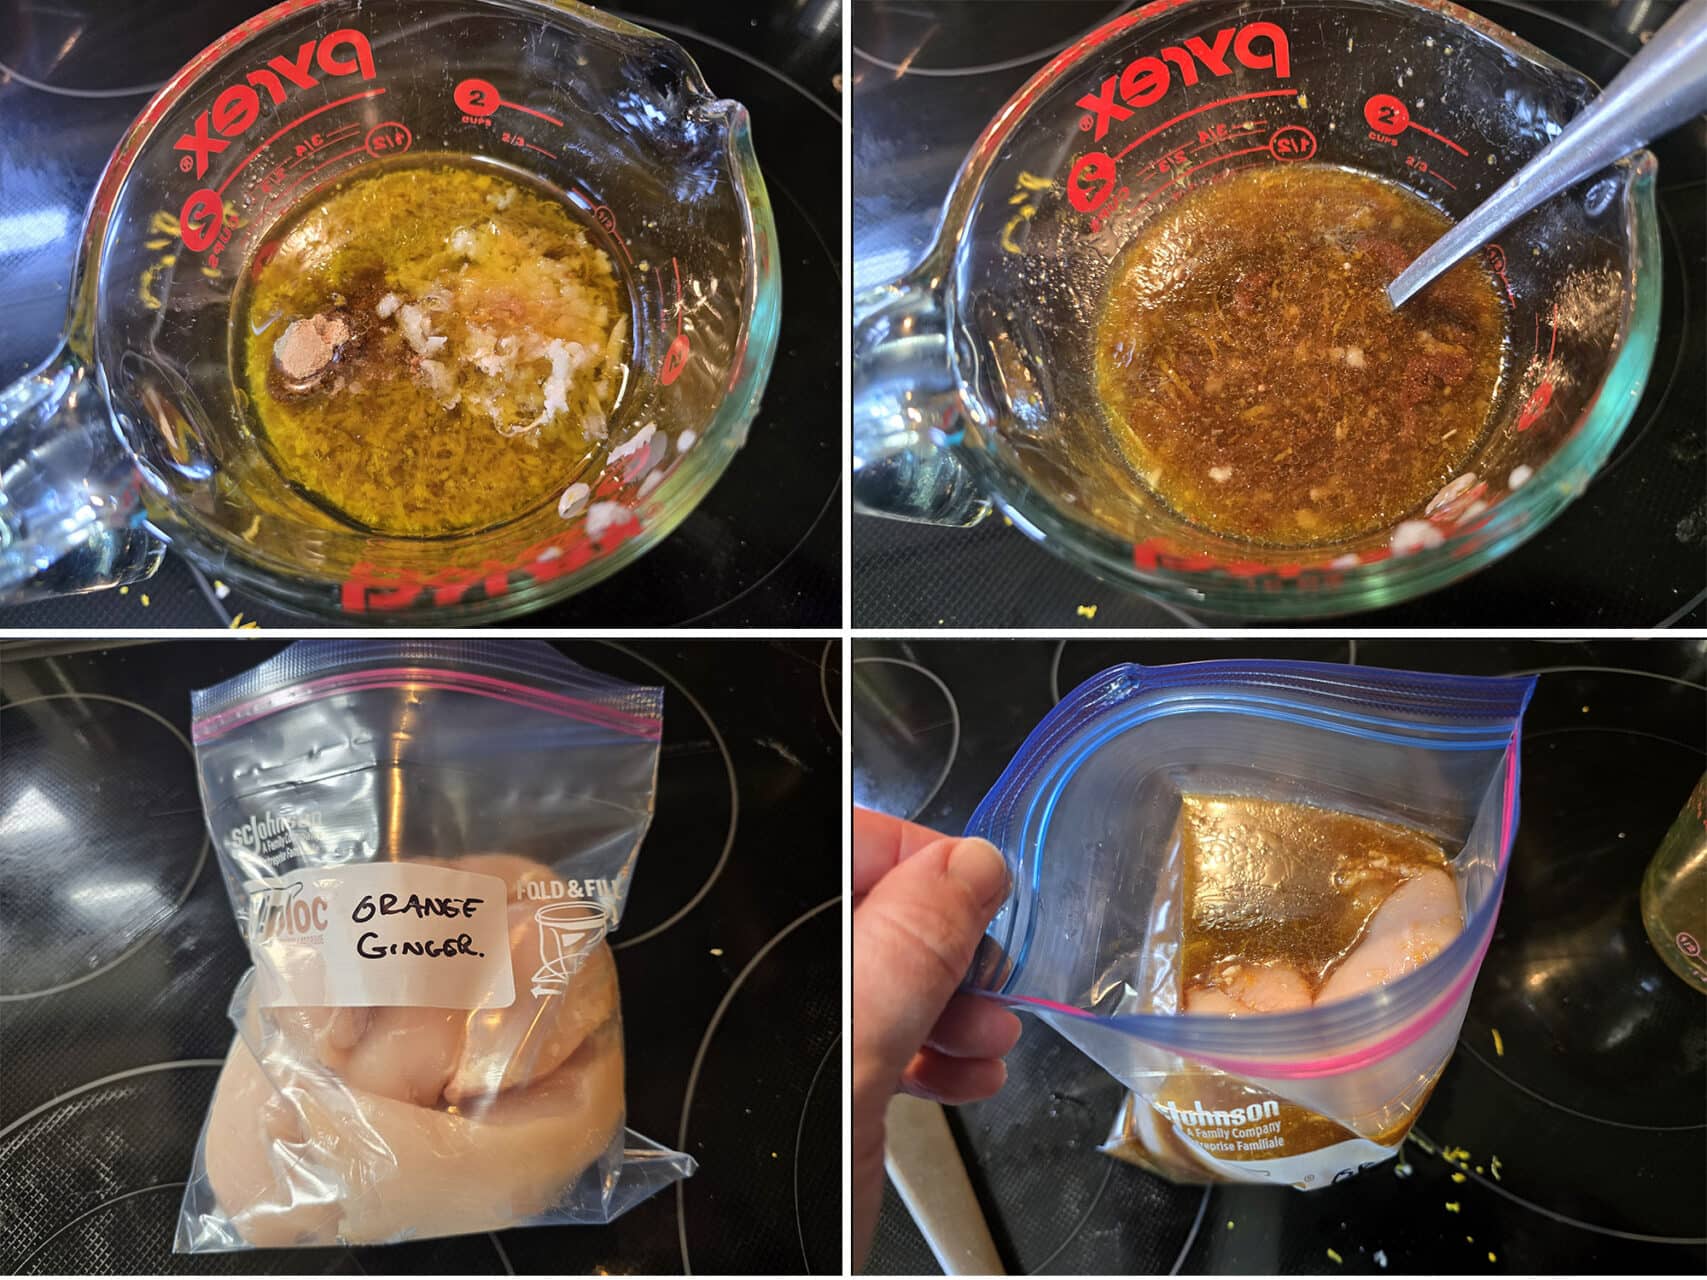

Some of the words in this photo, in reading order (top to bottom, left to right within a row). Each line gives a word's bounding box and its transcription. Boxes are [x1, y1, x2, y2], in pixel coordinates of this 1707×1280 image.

[469, 90, 486, 107] 2
[1378, 106, 1395, 125] 2
[1369, 131, 1398, 146] CUPS
[352, 893, 484, 923] ORANGE
[1196, 1126, 1230, 1140] Family
[1232, 1120, 1281, 1139] Company
[1237, 1136, 1284, 1152] Familiale
